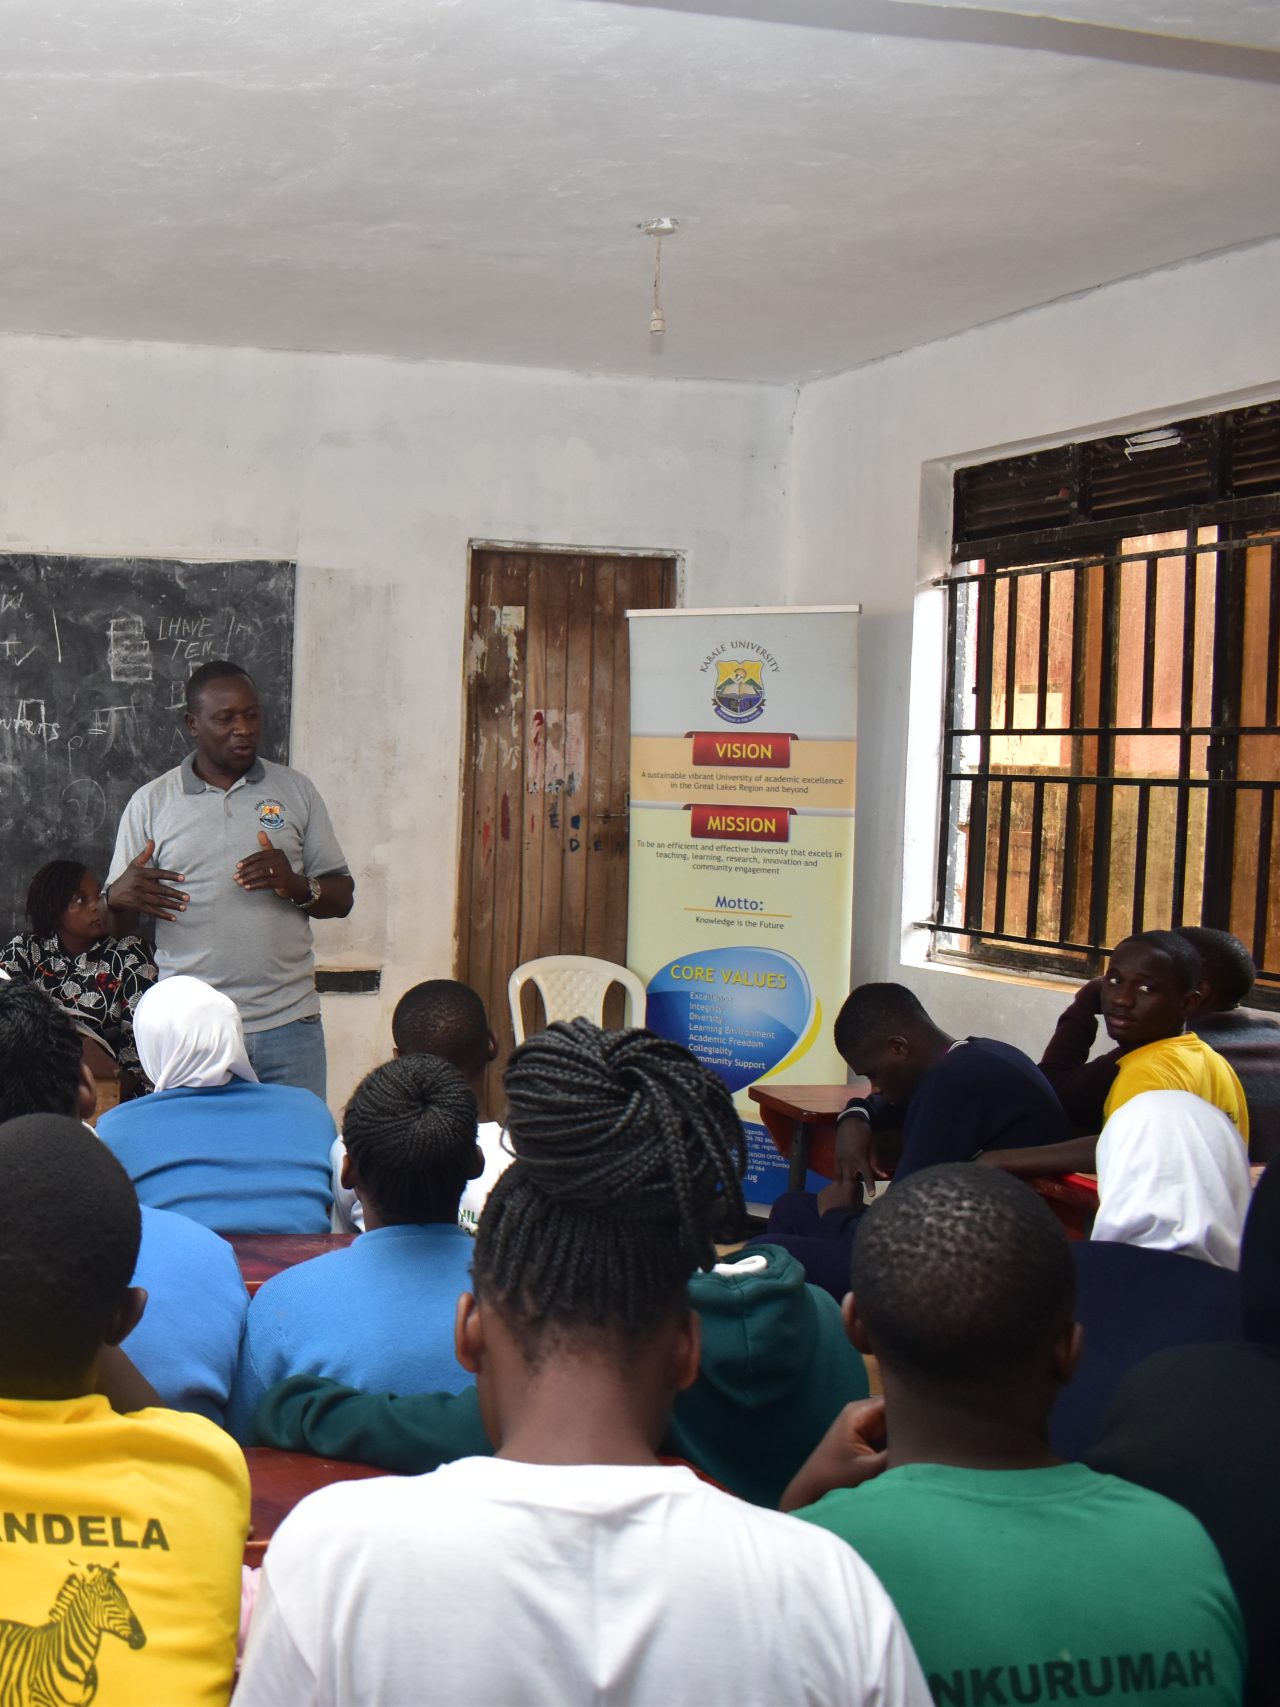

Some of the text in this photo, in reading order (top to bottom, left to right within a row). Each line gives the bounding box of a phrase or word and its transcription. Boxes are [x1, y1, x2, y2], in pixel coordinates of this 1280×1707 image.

[700, 640, 780, 673] KABALE UNIVERSITY
[716, 743, 772, 759] VISION
[647, 771, 686, 779] sustainable
[688, 772, 714, 780] vibrant
[716, 773, 752, 782] University
[765, 775, 799, 783] academic
[802, 777, 844, 785] excellence
[694, 782, 714, 790] Great
[716, 783, 736, 791] Lakes
[739, 784, 763, 792] Region
[782, 786, 809, 794] beyond
[707, 815, 776, 833] MISSION
[667, 842, 698, 851] efficient
[715, 844, 749, 852] effective
[751, 846, 788, 856] University
[790, 848, 805, 856] that
[808, 850, 832, 858] excels
[834, 850, 842, 858] in
[656, 852, 818, 867] teaching, learning, research, innovation and
[692, 863, 780, 875] community engagement
[715, 895, 763, 911] Motto:
[695, 916, 785, 929] Knowledge is the Future
[670, 965, 787, 989] CORE VALUES
[689, 1002, 724, 1013] Integrity
[689, 1012, 724, 1024] Diversity
[688, 1023, 776, 1039] Learning Environment
[688, 1033, 764, 1048] Academic Freedom
[688, 1043, 733, 1056] Collegiality
[697, 1055, 766, 1070] mmunity Support
[928, 1648, 1216, 1707] NKURUMAH
